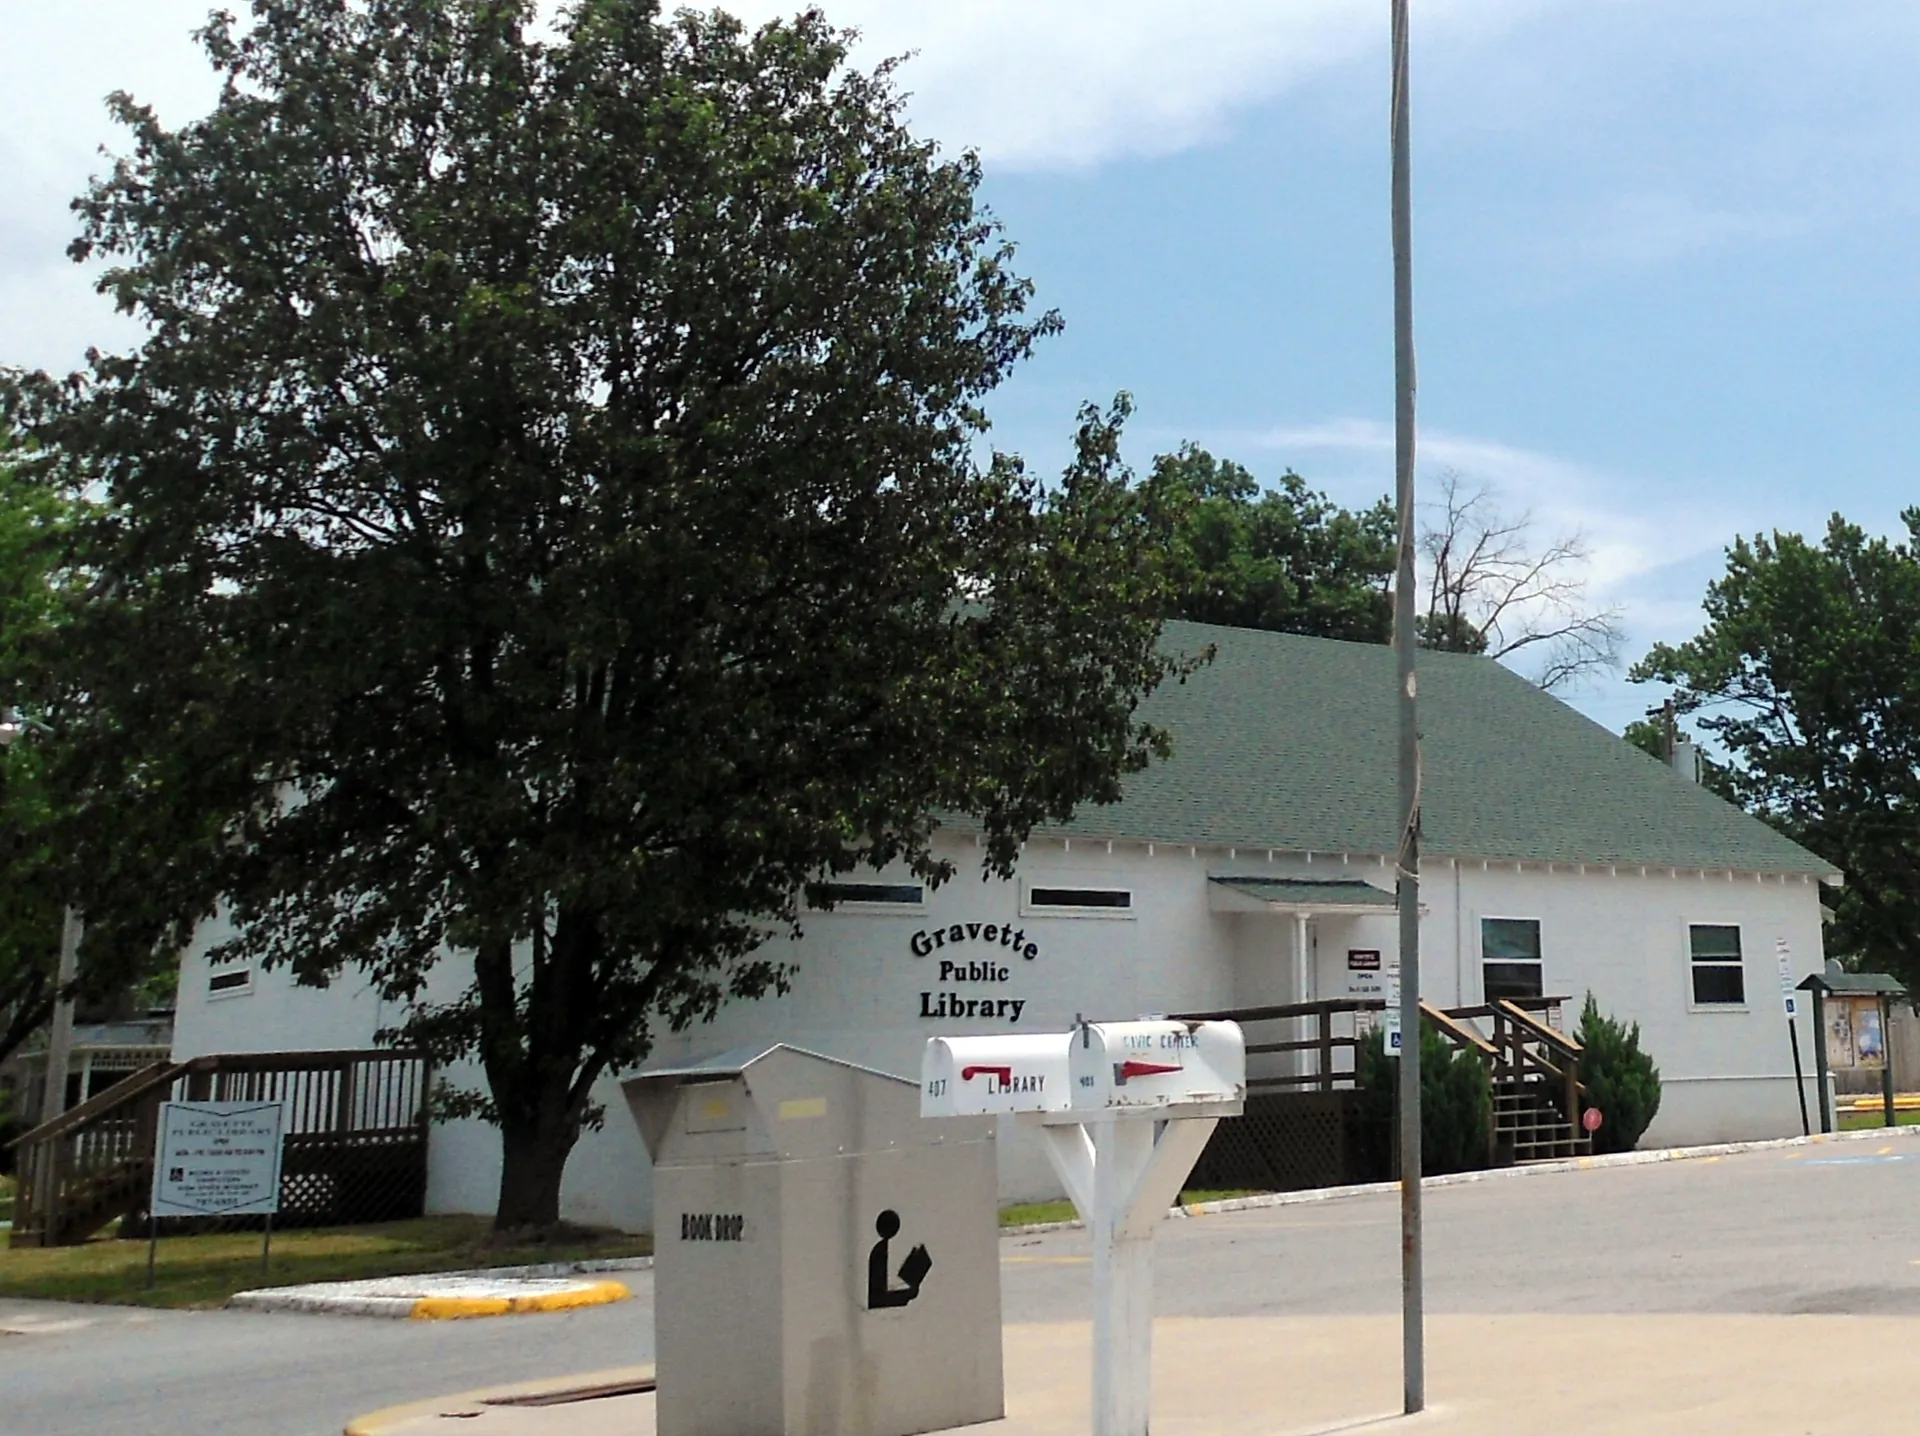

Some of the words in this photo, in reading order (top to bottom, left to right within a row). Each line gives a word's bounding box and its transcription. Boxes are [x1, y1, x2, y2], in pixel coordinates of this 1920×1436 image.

[911, 922, 1039, 960] Gravette
[939, 960, 1010, 982] Public
[920, 992, 1026, 1022] Library
[1124, 1034, 1153, 1049] CIVIC
[929, 1079, 947, 1098] 407
[681, 1213, 713, 1241] BOOK
[715, 1214, 744, 1242] DROP
